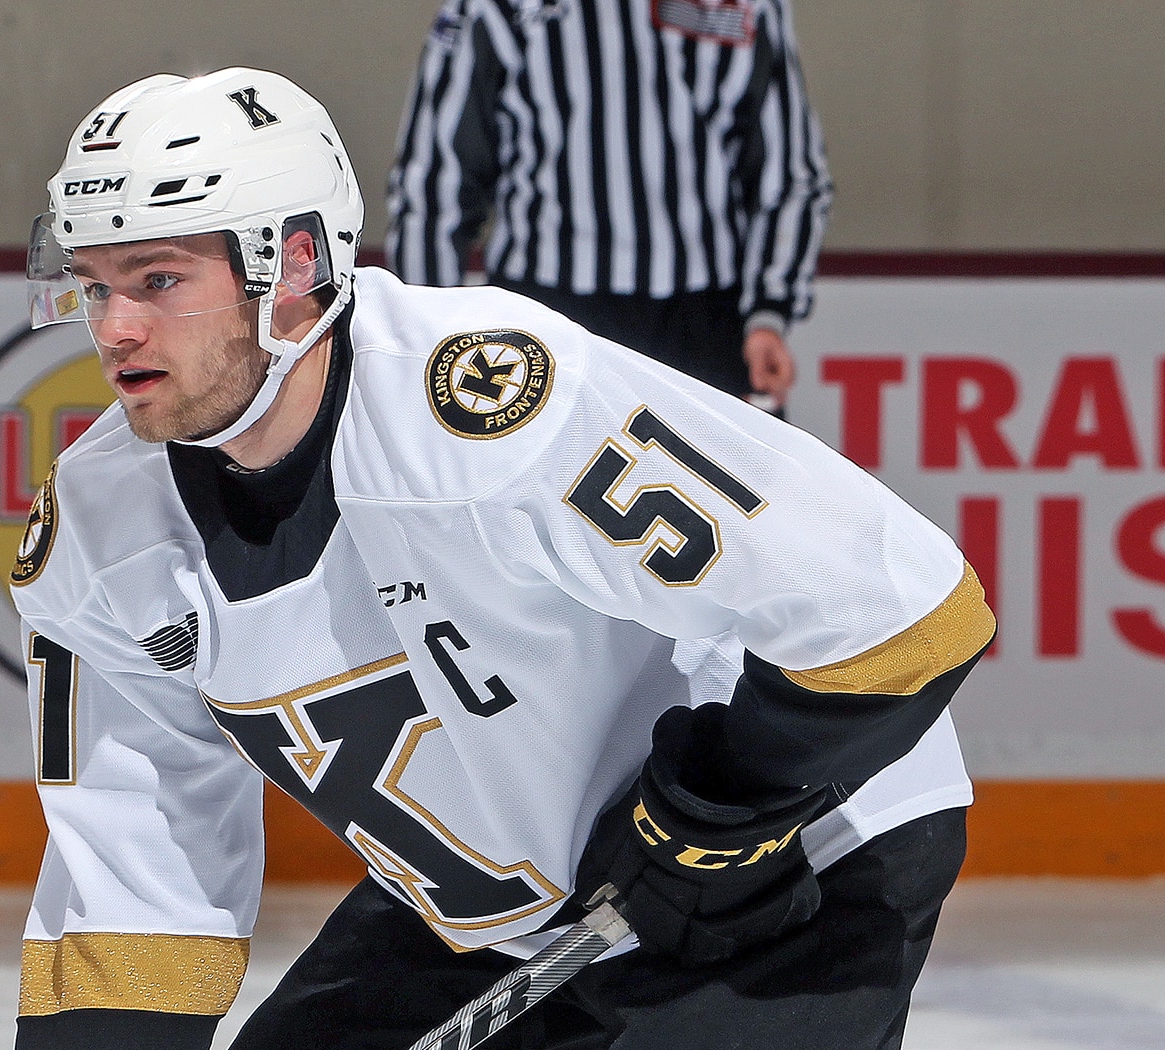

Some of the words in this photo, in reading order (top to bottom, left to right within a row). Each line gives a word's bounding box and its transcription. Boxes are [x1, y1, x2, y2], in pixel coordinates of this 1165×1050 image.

[81, 111, 129, 141] 51
[228, 86, 280, 130] K
[64, 177, 127, 196] CCM
[244, 284, 270, 293] CCM
[435, 334, 485, 407] KINGSTON
[455, 346, 520, 405] K
[484, 343, 545, 429] FRONTENACS
[819, 355, 1165, 471] TRA
[562, 404, 769, 587] 51
[373, 581, 428, 607] CM
[423, 620, 518, 718] C
[199, 653, 566, 952] K
[634, 799, 805, 870] CCM
